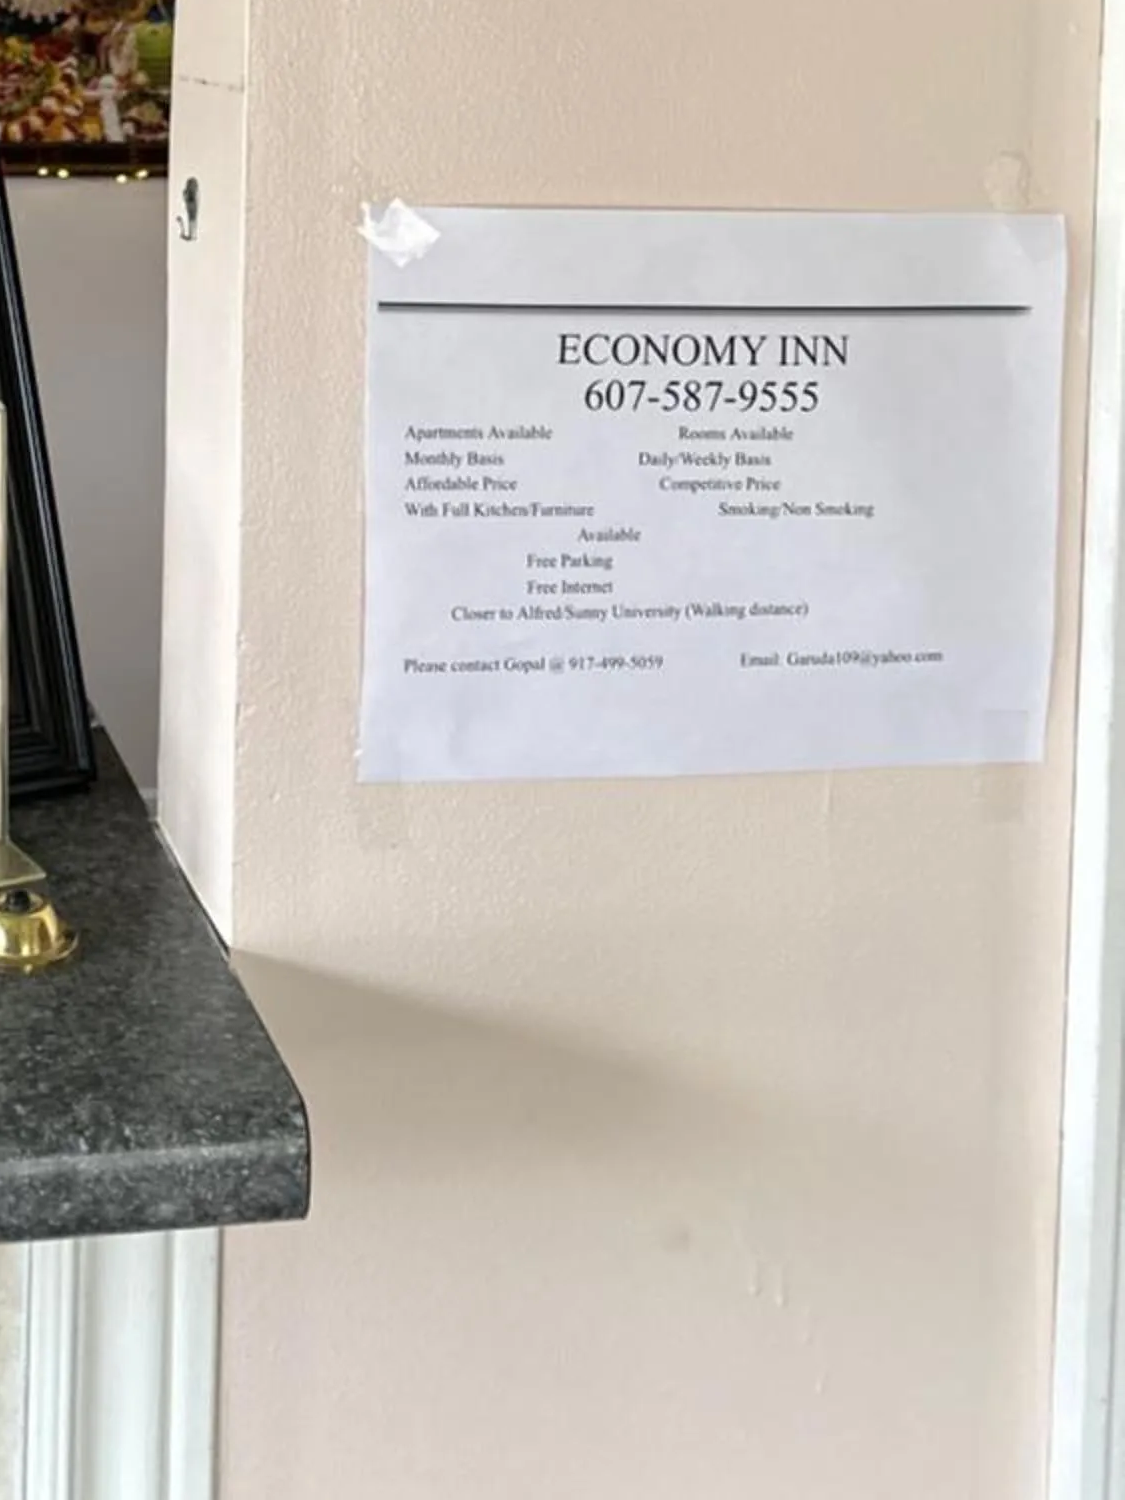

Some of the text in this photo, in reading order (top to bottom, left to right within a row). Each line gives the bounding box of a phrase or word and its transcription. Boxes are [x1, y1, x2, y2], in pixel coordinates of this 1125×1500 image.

[557, 334, 849, 366] ECONOMY INN
[584, 380, 819, 413] 607-587-9555
[404, 425, 553, 442] Apartments Available
[678, 426, 794, 441] Rooms Available
[404, 451, 504, 468] Monthly Basis
[735, 452, 771, 466] Basis
[405, 476, 518, 491] Affordable Price
[659, 476, 781, 493] Competitive Price
[404, 502, 437, 517] With
[442, 502, 469, 517] Full
[815, 502, 875, 519] Smoking
[577, 528, 640, 542] Available
[526, 553, 613, 570] Free Parking
[526, 580, 613, 595] Free Internet
[451, 606, 495, 621] Closer
[500, 607, 513, 621] to
[612, 604, 680, 620] University
[684, 602, 745, 619] (Walking
[749, 601, 809, 617] distance)
[404, 659, 447, 674] Please
[451, 658, 499, 673] contact
[503, 658, 545, 675] Gopal
[569, 655, 663, 670] 917-499-5059
